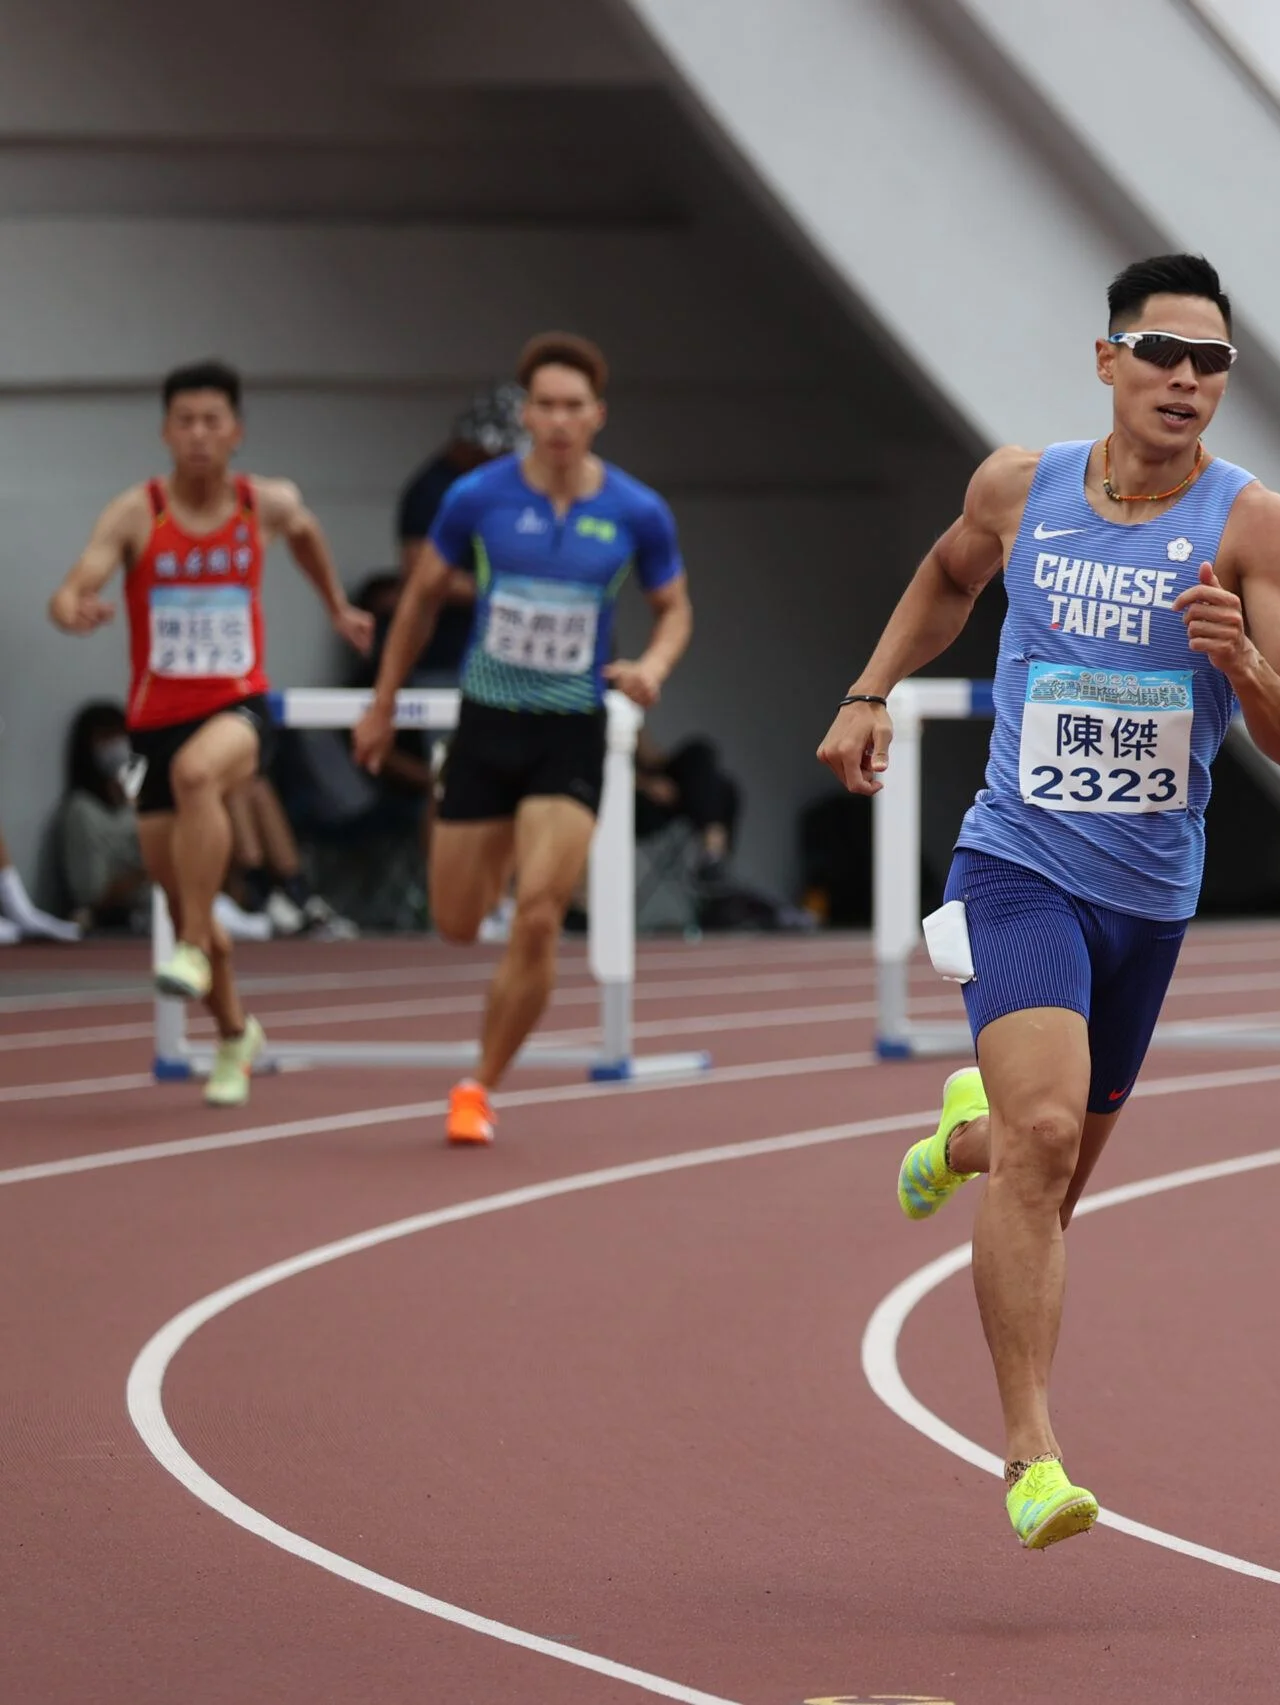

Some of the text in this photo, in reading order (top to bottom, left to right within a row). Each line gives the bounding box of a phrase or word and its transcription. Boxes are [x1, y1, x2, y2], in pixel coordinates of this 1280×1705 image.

[1033, 552, 1178, 610] CHINESE
[1048, 594, 1151, 644] TAIPEI
[1080, 671, 1138, 687] 2022
[1056, 713, 1158, 761] 陳傑
[1030, 765, 1178, 803] 2323
